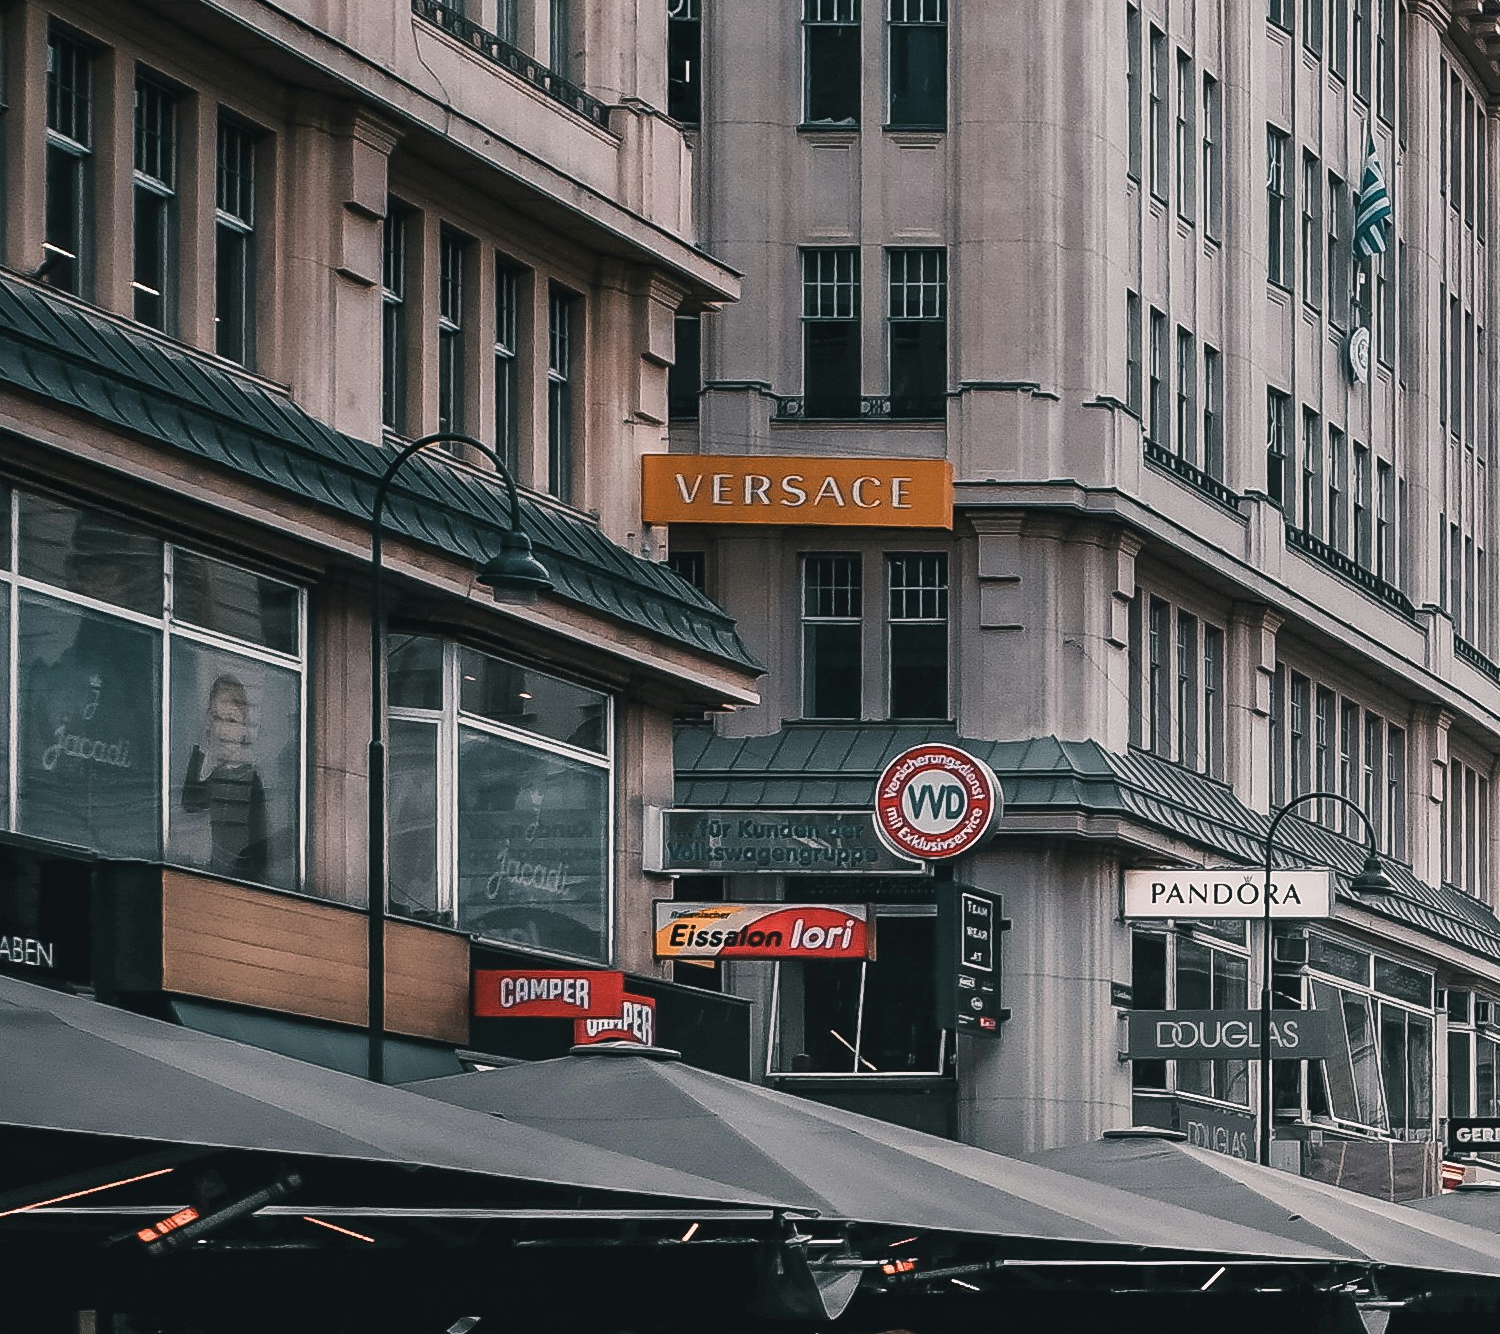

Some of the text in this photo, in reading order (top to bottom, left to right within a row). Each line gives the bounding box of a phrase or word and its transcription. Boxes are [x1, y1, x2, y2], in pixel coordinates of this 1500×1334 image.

[674, 473, 912, 510] VERSACE
[883, 754, 986, 800] Versicherungsdienst
[737, 818, 819, 838] Kunden
[886, 807, 983, 852] mit Exklusivservice
[1151, 882, 1301, 905] PANDORA
[669, 923, 783, 948] Eissalon
[500, 977, 589, 1009] CAMPER
[1156, 1021, 1299, 1048] DOUGLAS
